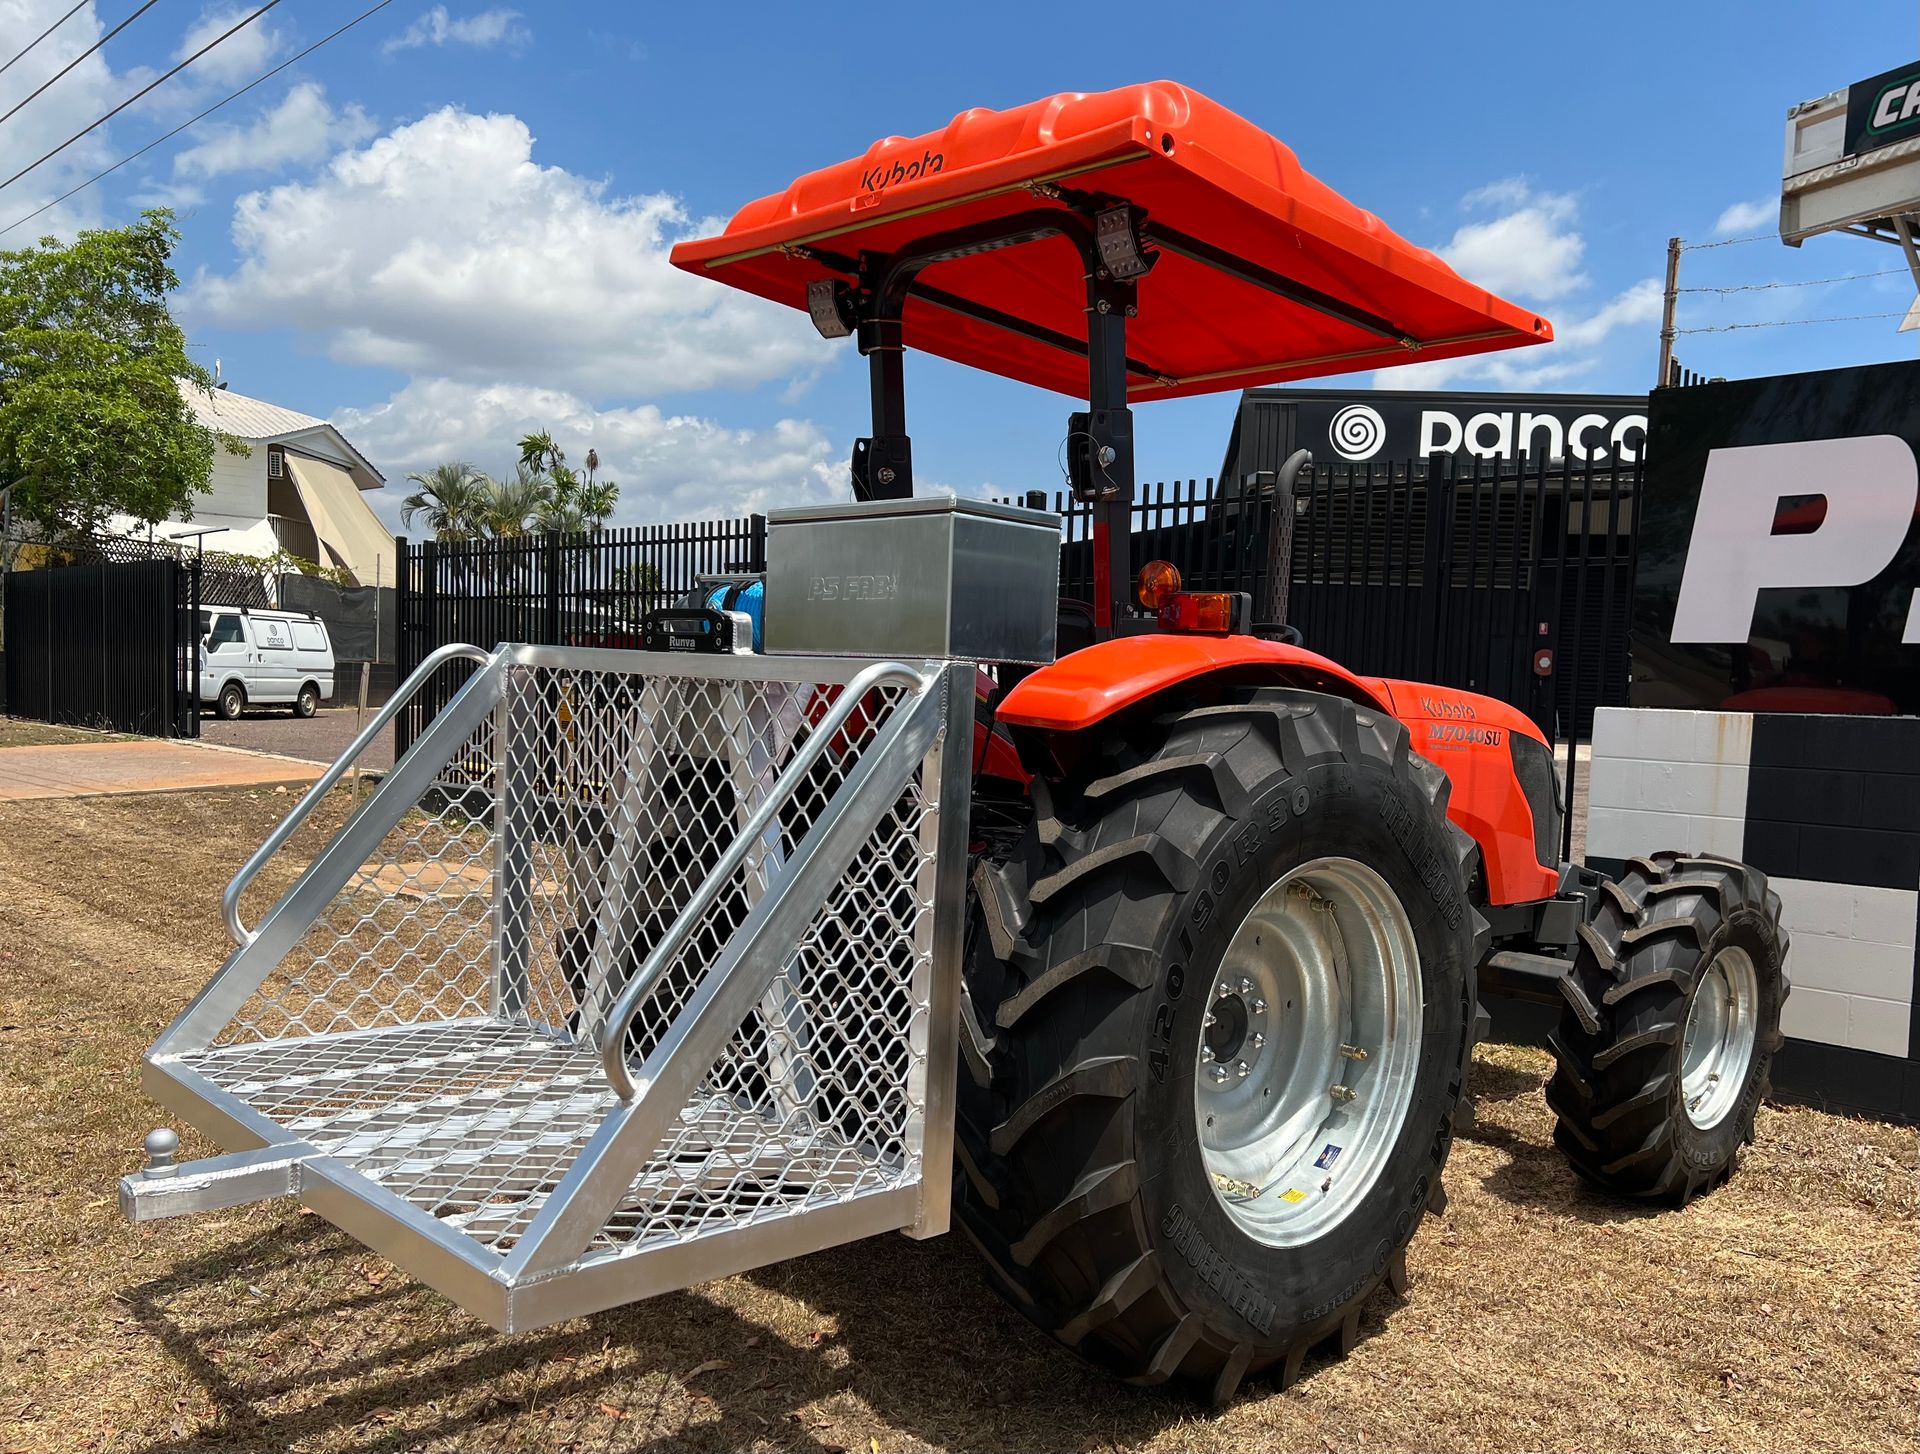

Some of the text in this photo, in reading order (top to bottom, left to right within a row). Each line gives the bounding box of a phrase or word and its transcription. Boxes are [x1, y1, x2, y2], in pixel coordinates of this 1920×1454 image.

[860, 150, 945, 193] Kubota
[1418, 409, 1649, 463] panco
[1670, 434, 1920, 645] P
[669, 635, 696, 648] Runva
[1420, 696, 1477, 720] Kubota
[1428, 723, 1502, 747] M7040SU
[1378, 782, 1465, 932] TRELLEBORG
[1160, 1202, 1279, 1338] TRELLEBORG
